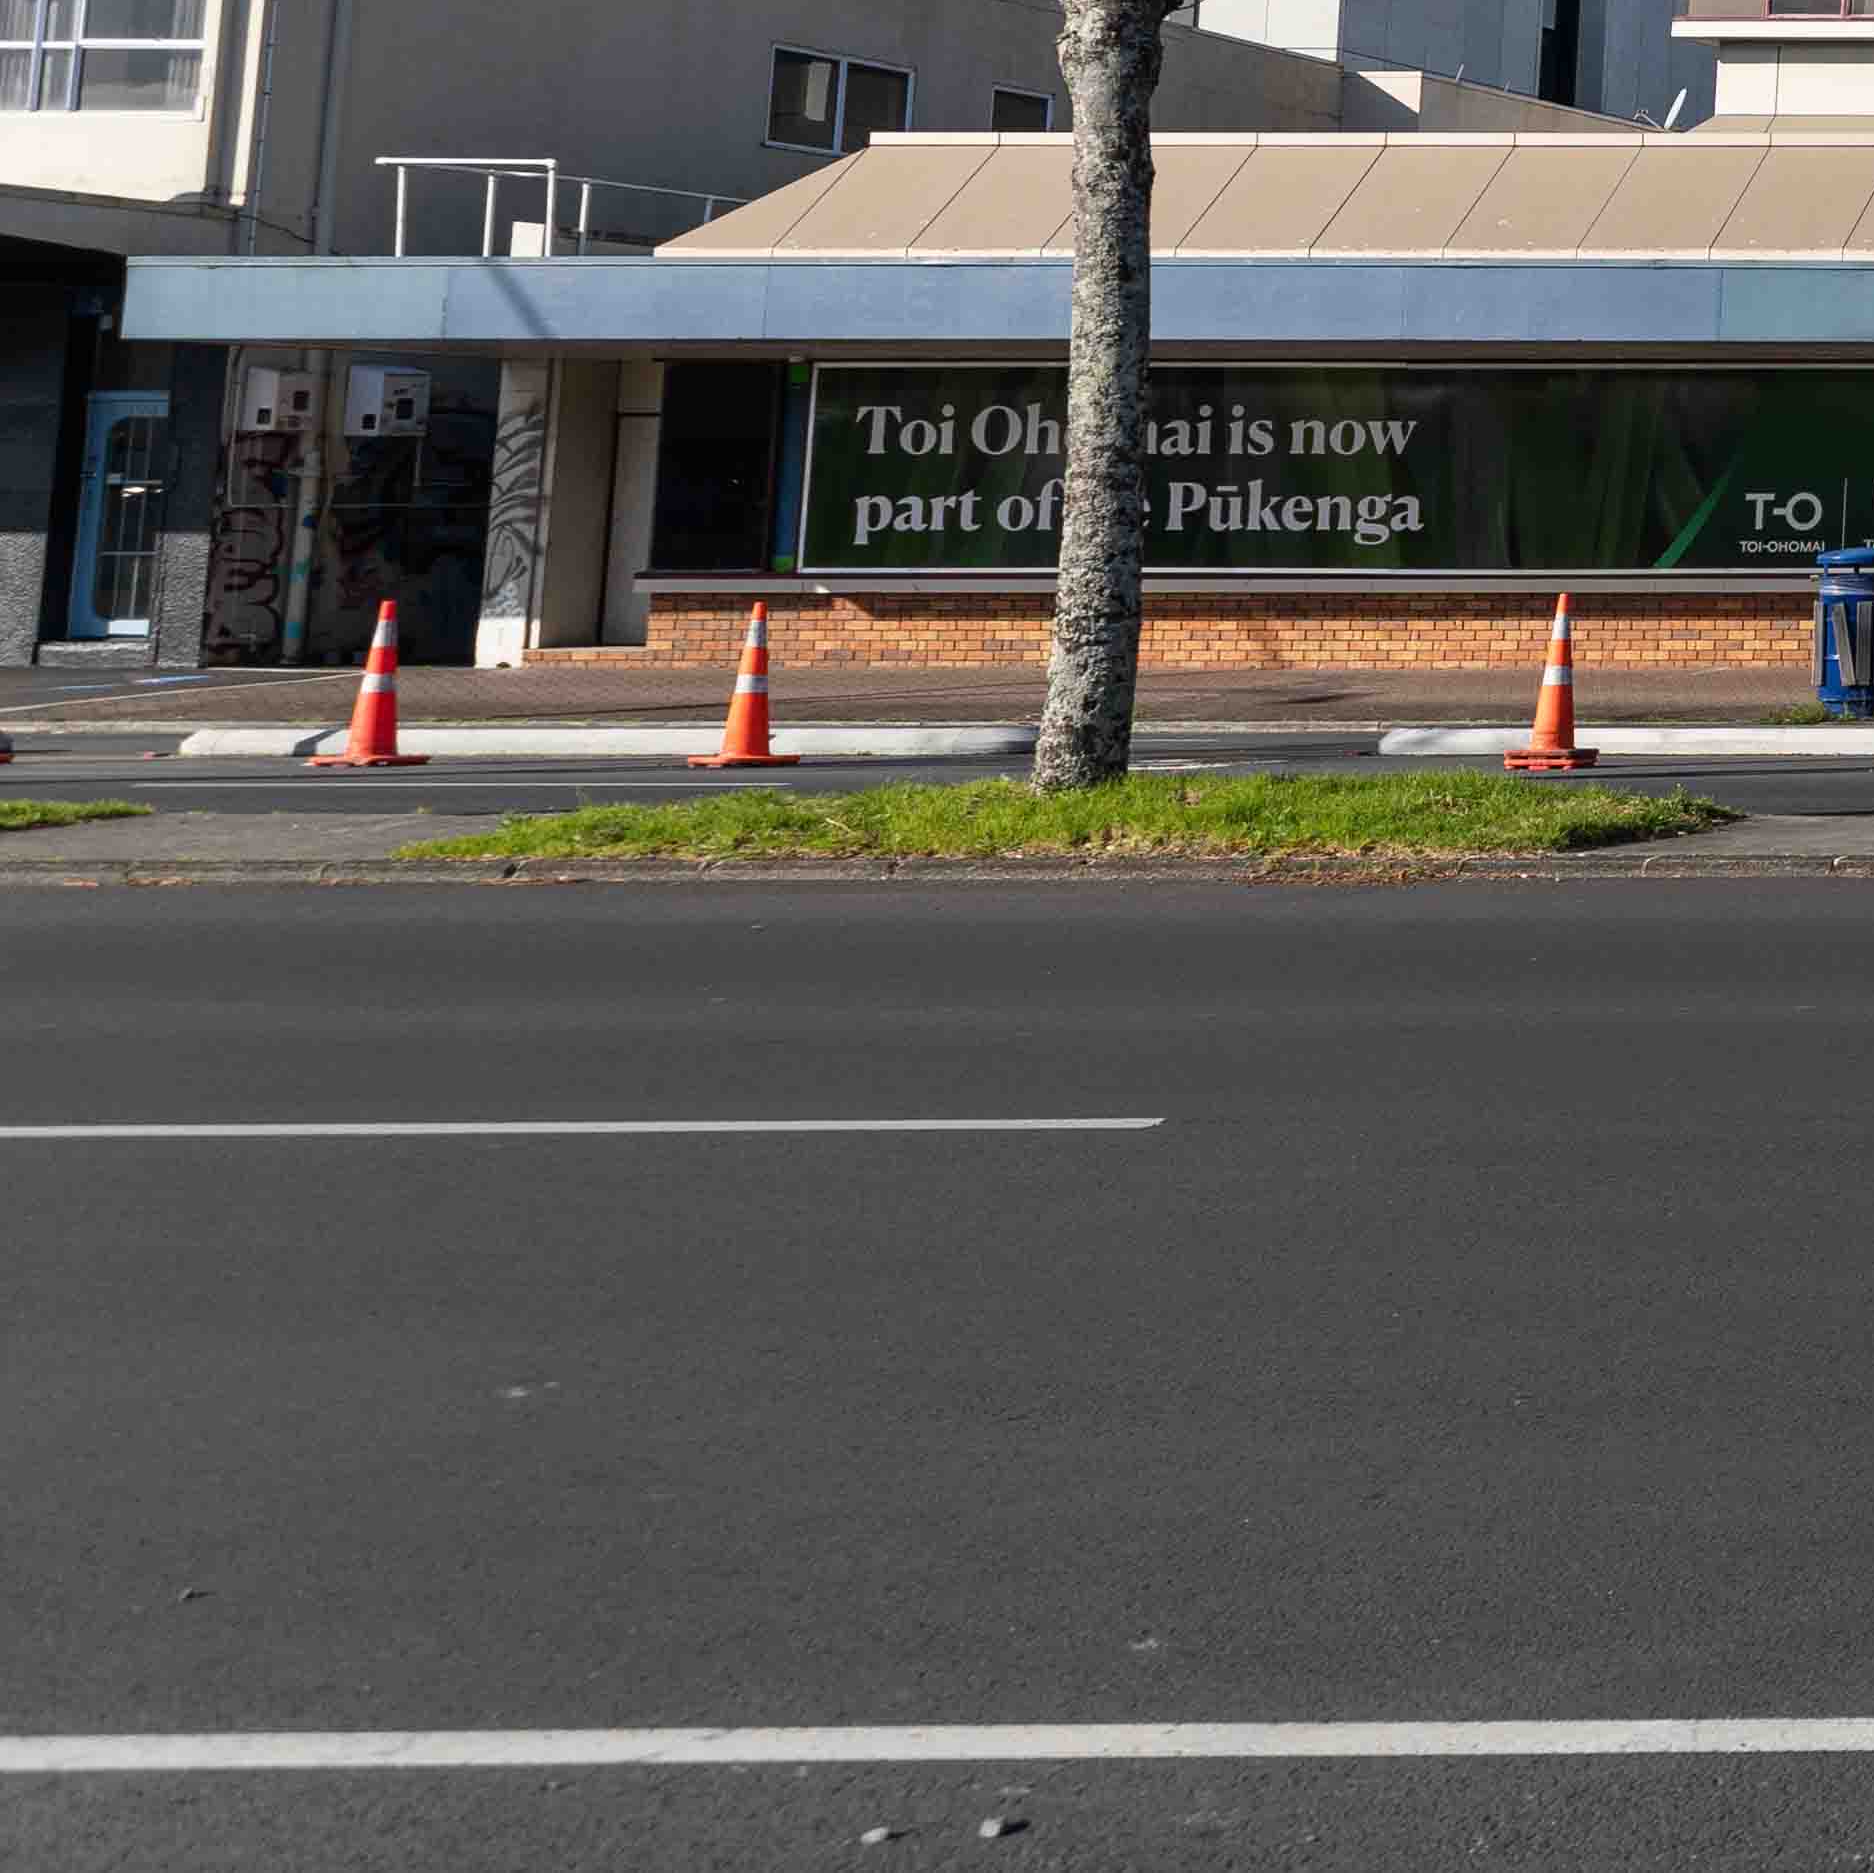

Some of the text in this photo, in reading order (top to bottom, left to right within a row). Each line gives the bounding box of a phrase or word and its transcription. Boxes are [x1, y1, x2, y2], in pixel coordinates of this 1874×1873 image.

[856, 404, 955, 455] Toi
[1229, 405, 1274, 455] is
[1289, 419, 1417, 455] now
[853, 489, 982, 546] part
[996, 478, 1064, 531] of
[1164, 478, 1425, 546] Pūkenga
